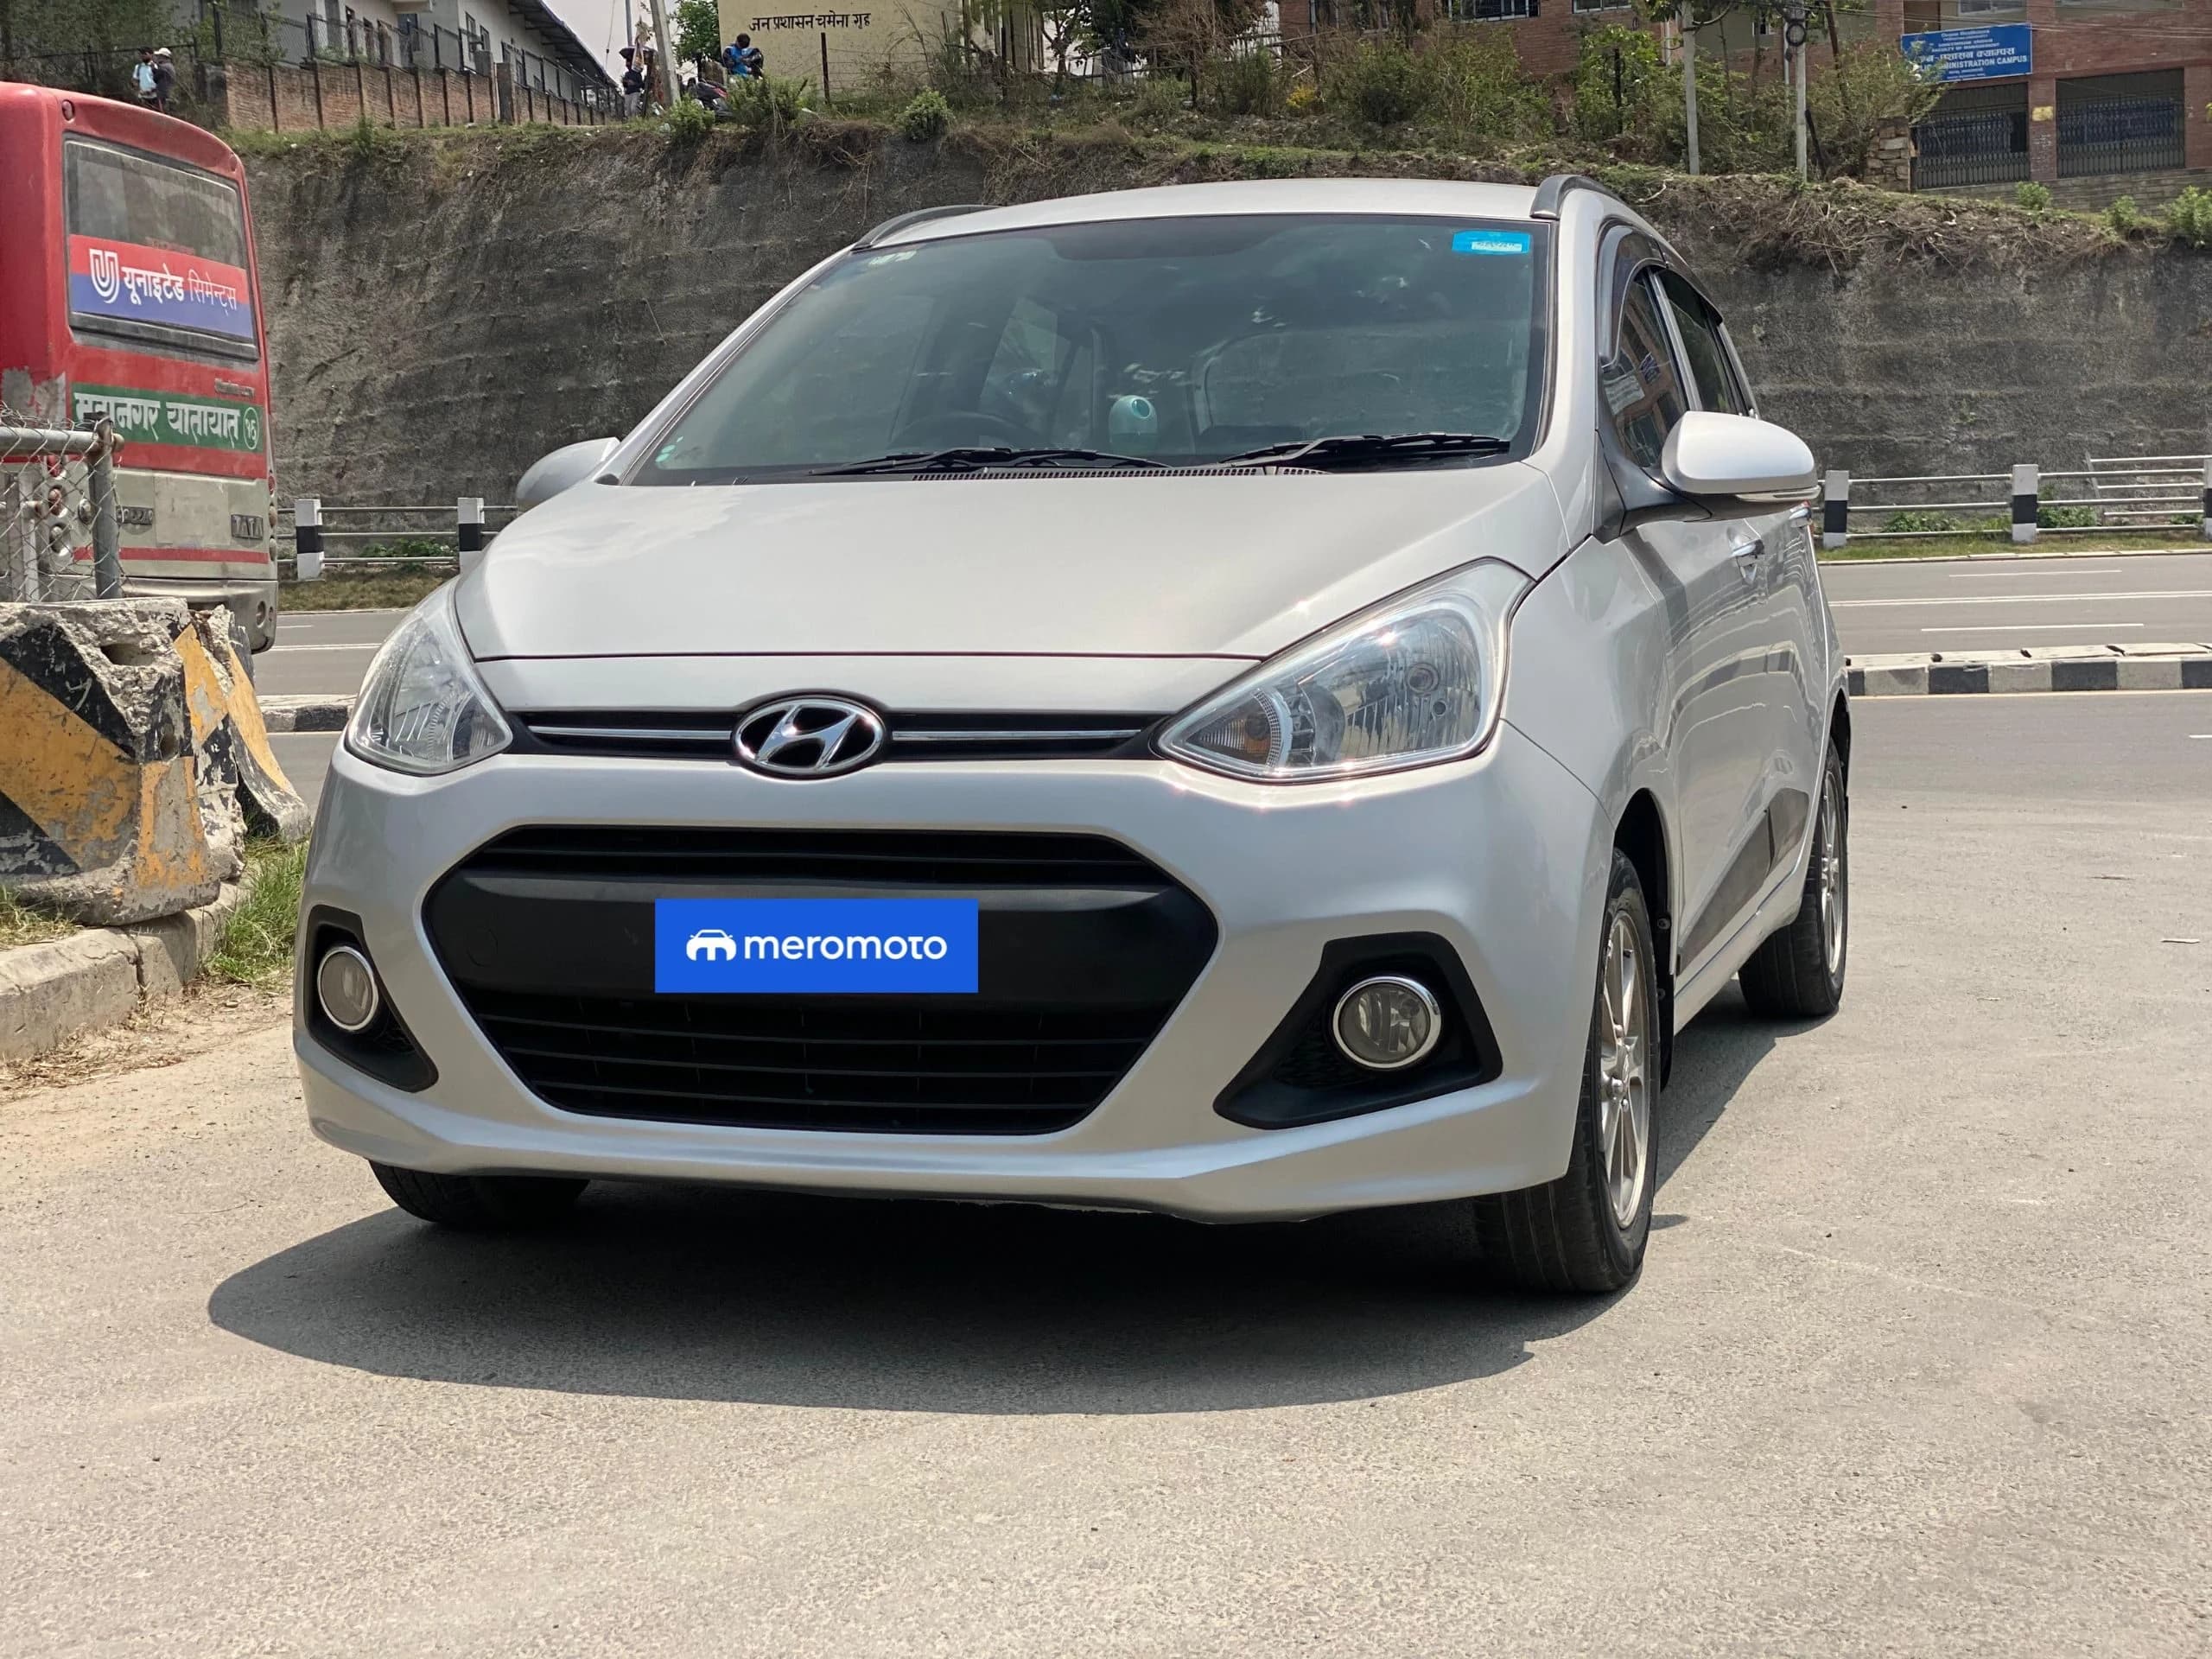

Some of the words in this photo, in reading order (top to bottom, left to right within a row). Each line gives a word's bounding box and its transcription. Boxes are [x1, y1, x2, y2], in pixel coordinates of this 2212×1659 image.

[749, 17, 773, 31] जन
[773, 15, 815, 30] प्रशासन
[816, 10, 850, 29] चमेना
[853, 13, 871, 29] गृह
[1997, 54, 2028, 65] CAMPUS
[121, 263, 185, 305] यूनाइटेड
[188, 269, 238, 316] सिमेन्ट्स
[166, 401, 240, 448] यातायात
[232, 515, 263, 538] TATA
